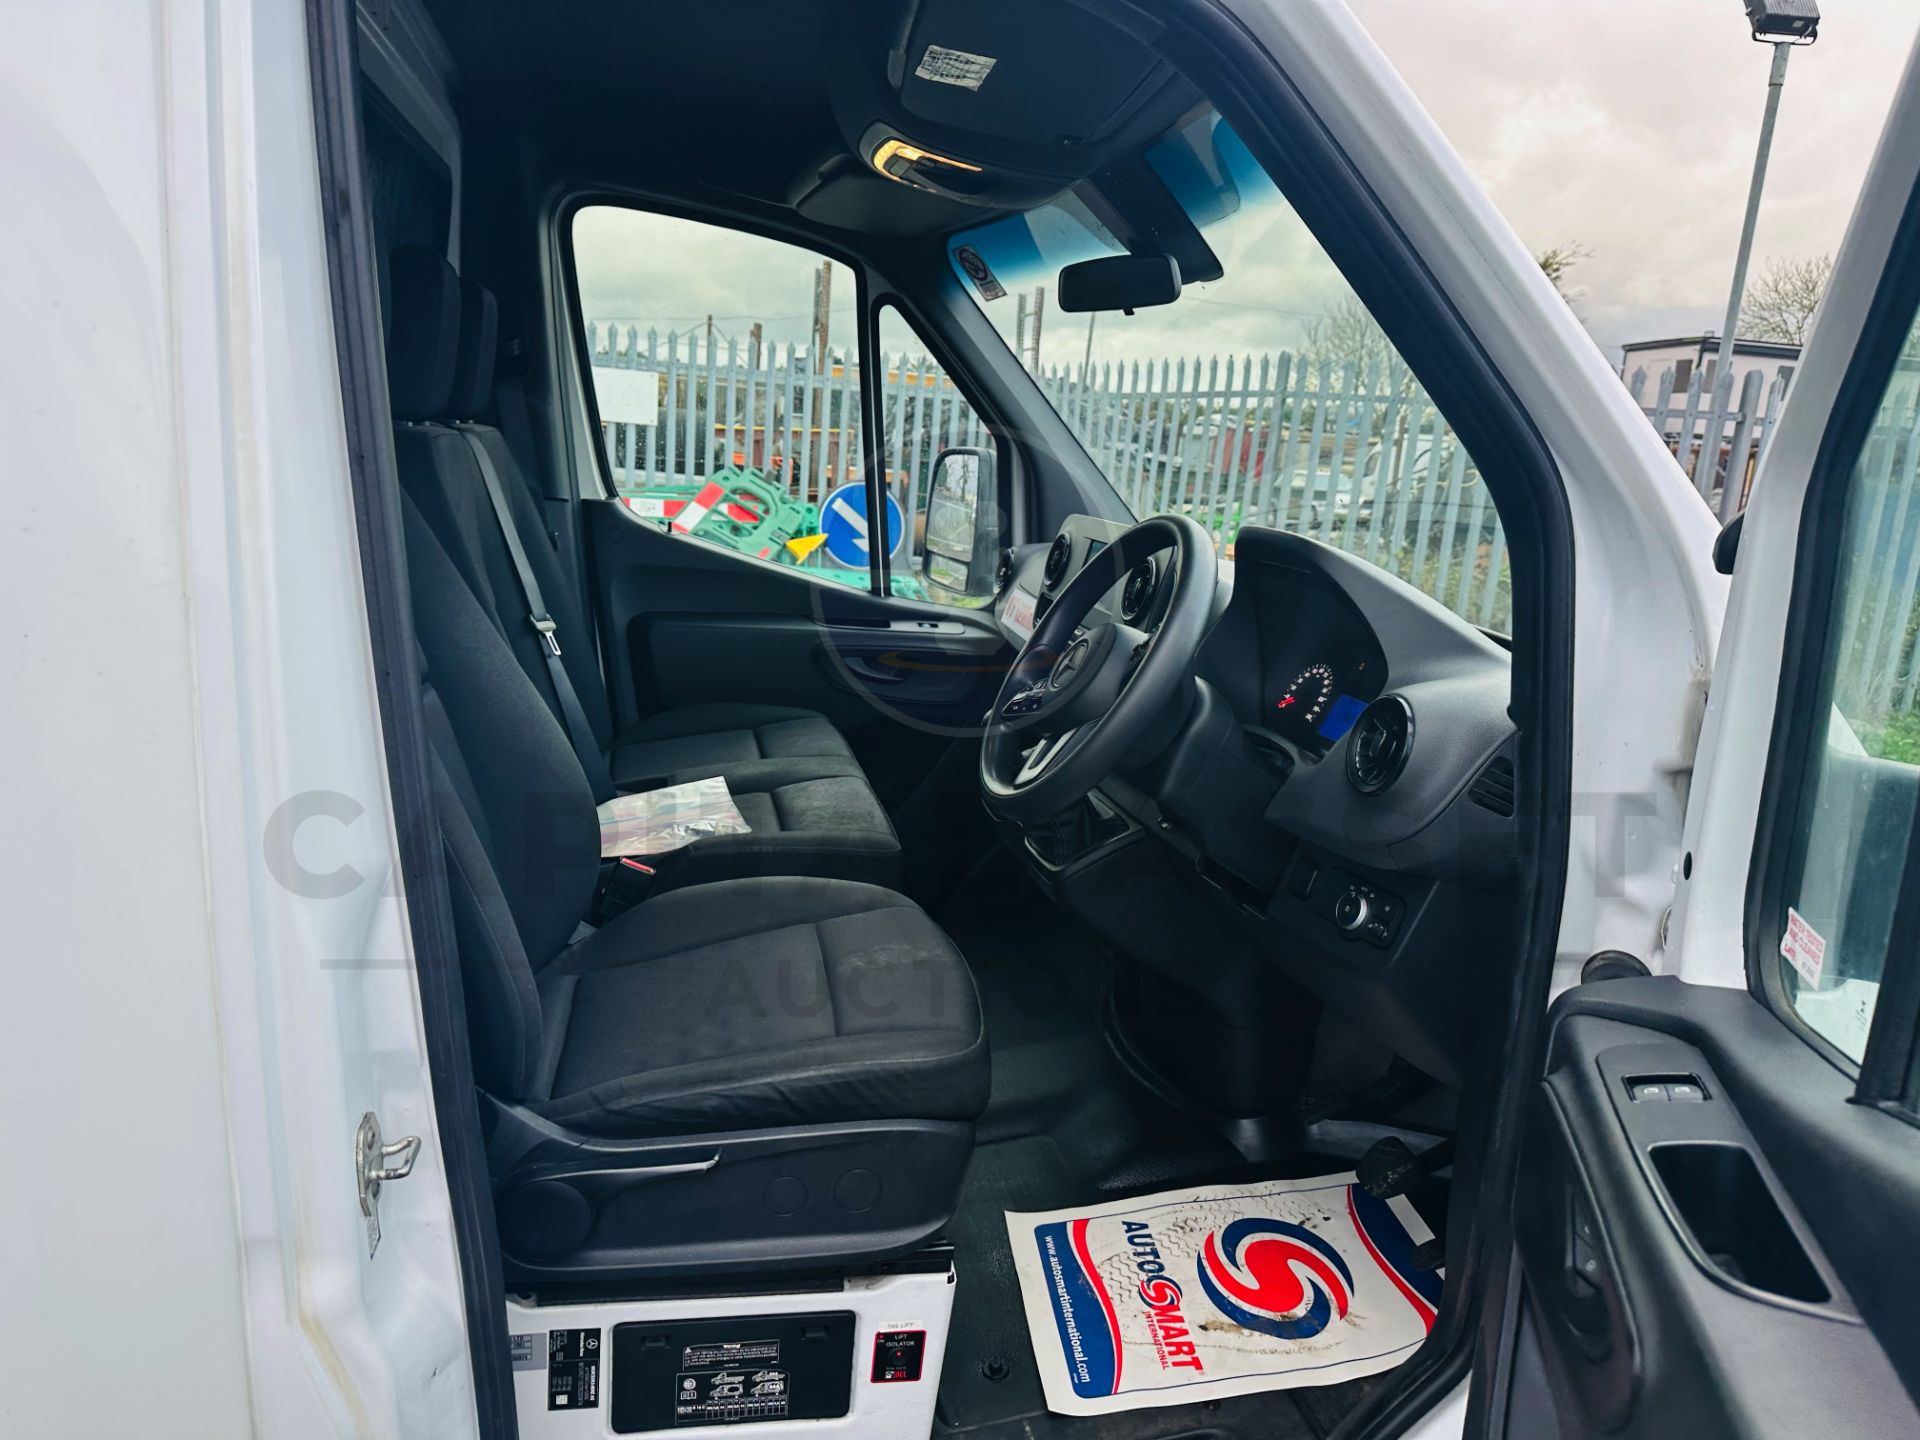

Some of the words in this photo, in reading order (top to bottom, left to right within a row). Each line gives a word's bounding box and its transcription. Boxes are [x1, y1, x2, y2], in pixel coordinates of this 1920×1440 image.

[1044, 1235, 1090, 1383] www.autosmartinternational.com
[1122, 1221, 1203, 1372] AUTOSMART
[1144, 1311, 1170, 1370] INTERNATIONAL
